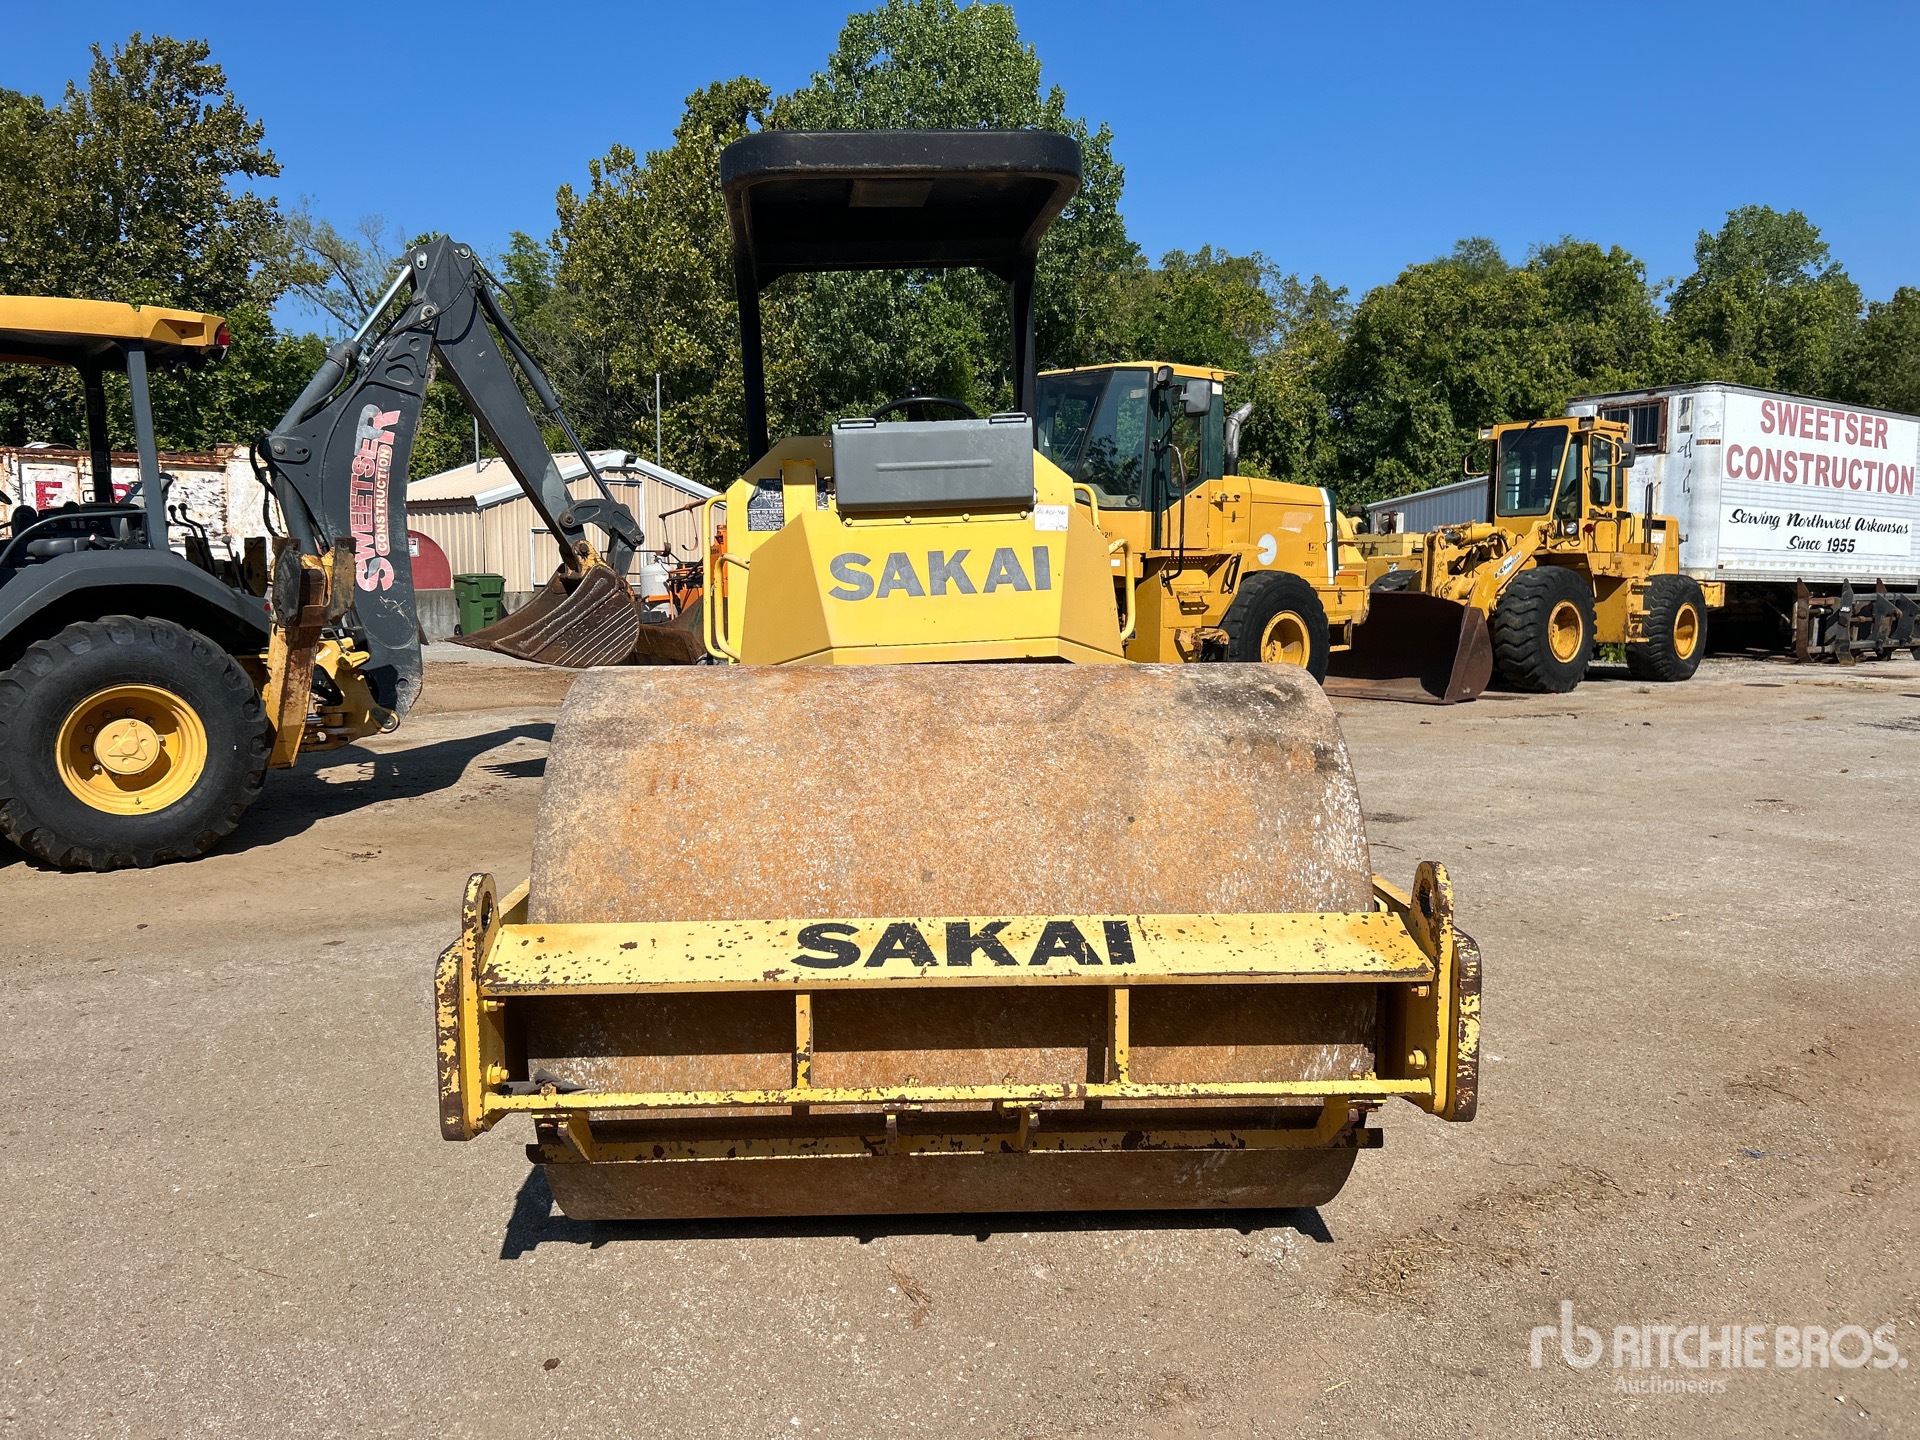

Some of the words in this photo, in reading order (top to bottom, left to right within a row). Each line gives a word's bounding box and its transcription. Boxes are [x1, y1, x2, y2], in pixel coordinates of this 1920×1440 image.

[1760, 399, 1888, 450] SWEETSER
[1726, 443, 1915, 496] CONSTRUCTION
[350, 403, 401, 592] SWEETSER
[375, 447, 391, 551] CONSTRUCTION
[1728, 508, 1781, 531] Serving
[1786, 512, 1852, 531] Northwest
[1854, 517, 1909, 535] Arkansas
[1786, 535, 1822, 550] Since
[1826, 537, 1856, 553] 1955
[828, 546, 1052, 601] SAKAI
[790, 920, 1136, 969] SAKAI
